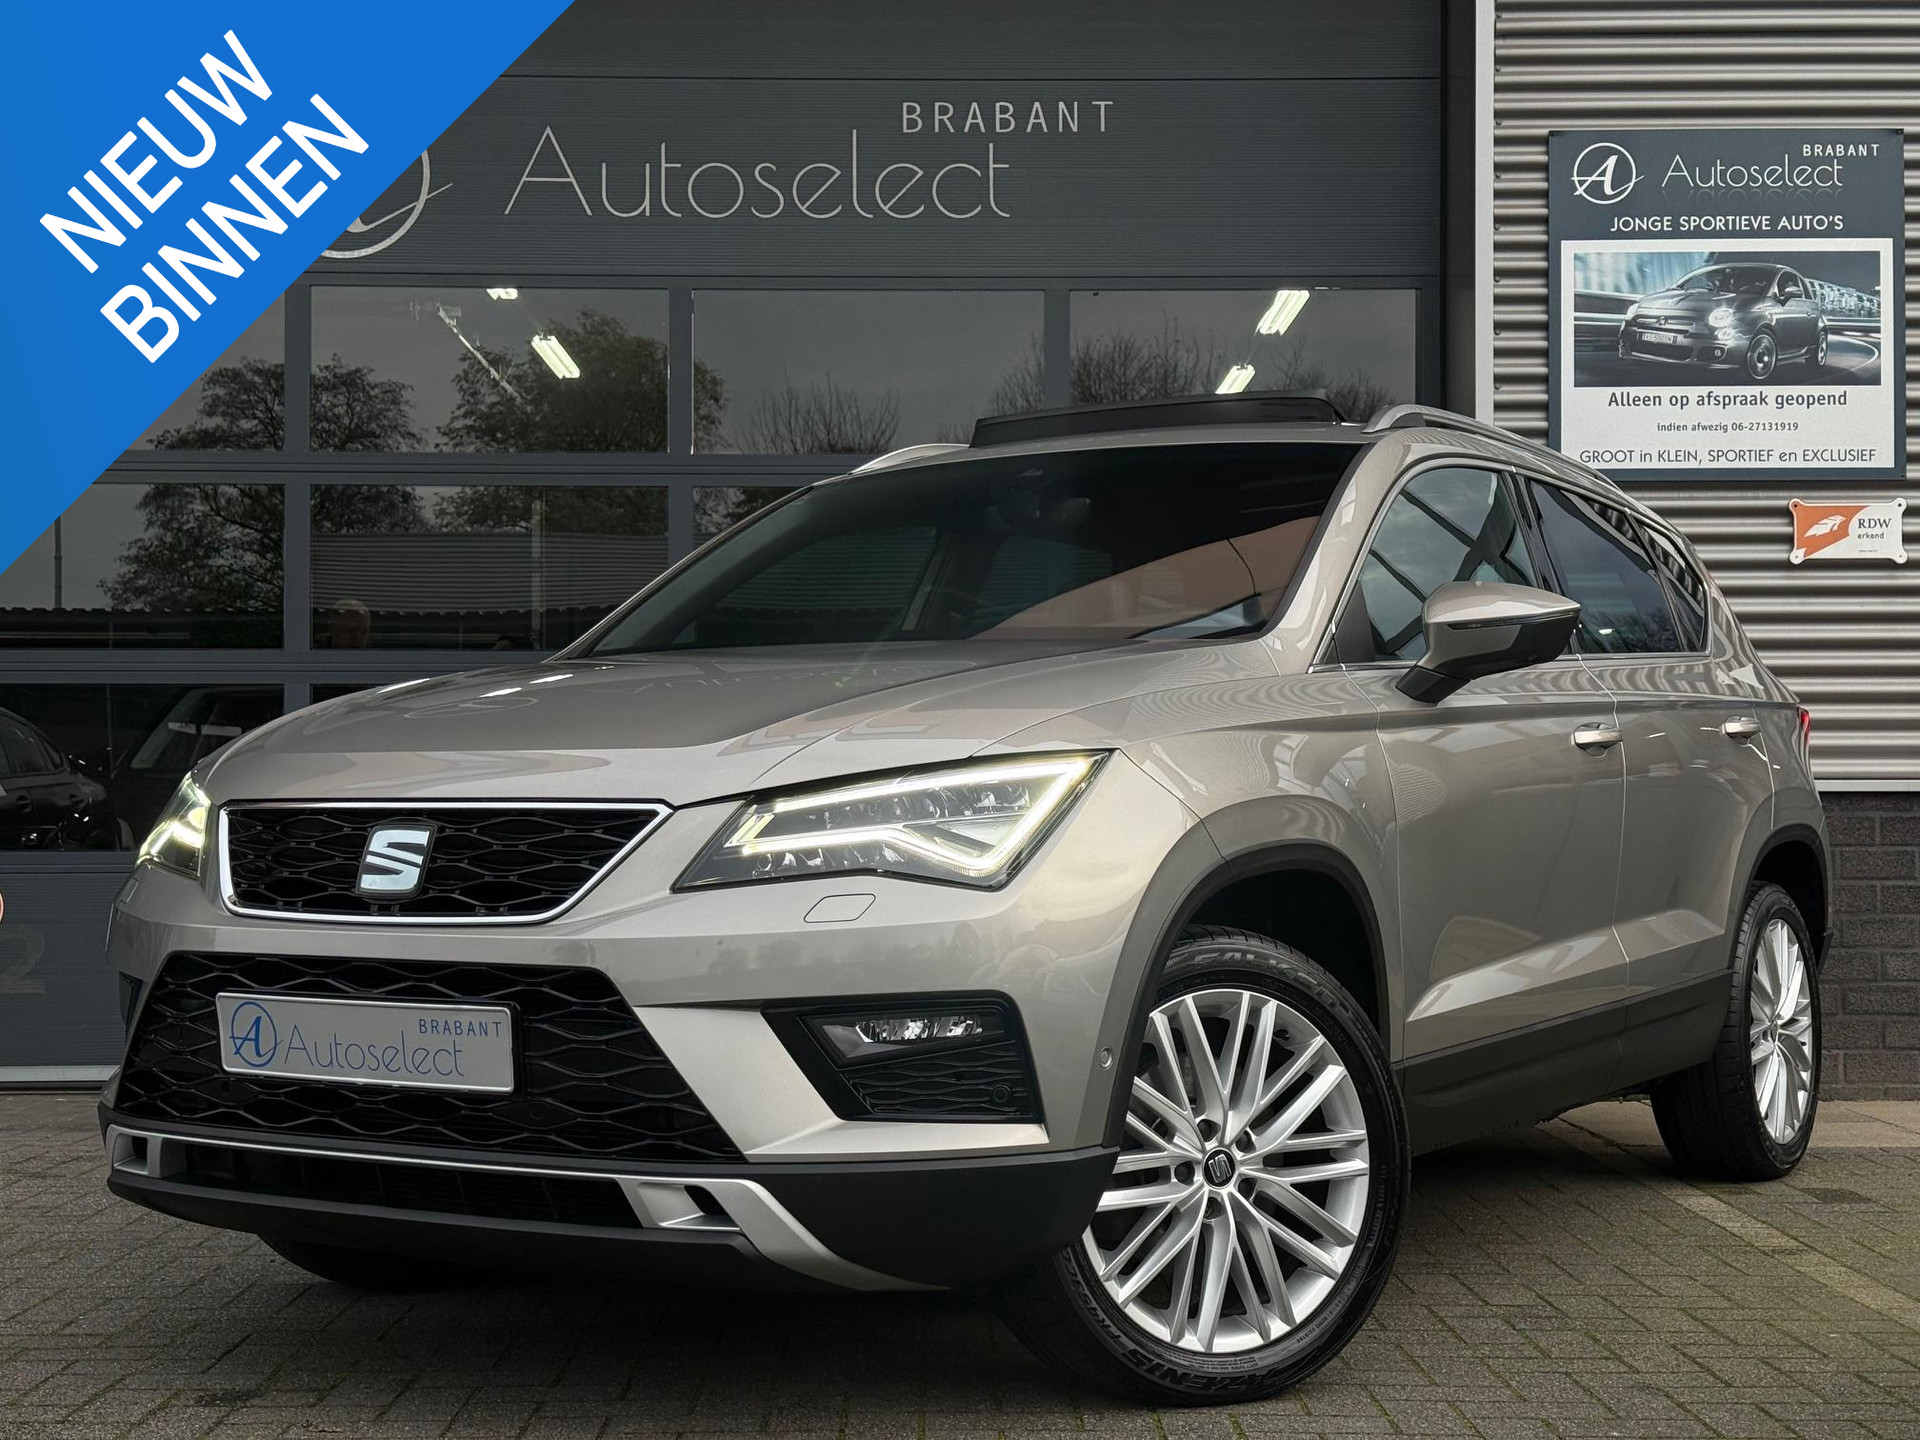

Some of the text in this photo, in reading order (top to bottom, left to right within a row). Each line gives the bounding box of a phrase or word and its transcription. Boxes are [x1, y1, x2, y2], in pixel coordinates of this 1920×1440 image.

[902, 101, 1114, 134] BRABANT
[1802, 144, 1880, 158] BRABANT
[504, 125, 1011, 219] Autoselect
[1661, 154, 1843, 188] Autoselect
[1610, 215, 1844, 233] JONGE SPORTIEVE AUTO'S
[1608, 390, 1848, 409] Alleen op afspraak geopend
[1656, 421, 1799, 433] indien afwezig 06-27131919
[1579, 448, 1877, 466] GROOT in KLEIN, SPORTIEF en EXCLUSIEF
[1858, 518, 1892, 529] RDW
[1857, 532, 1884, 540] erkend
[418, 1018, 502, 1037] BRABANT
[284, 1023, 465, 1077] Autoselect
